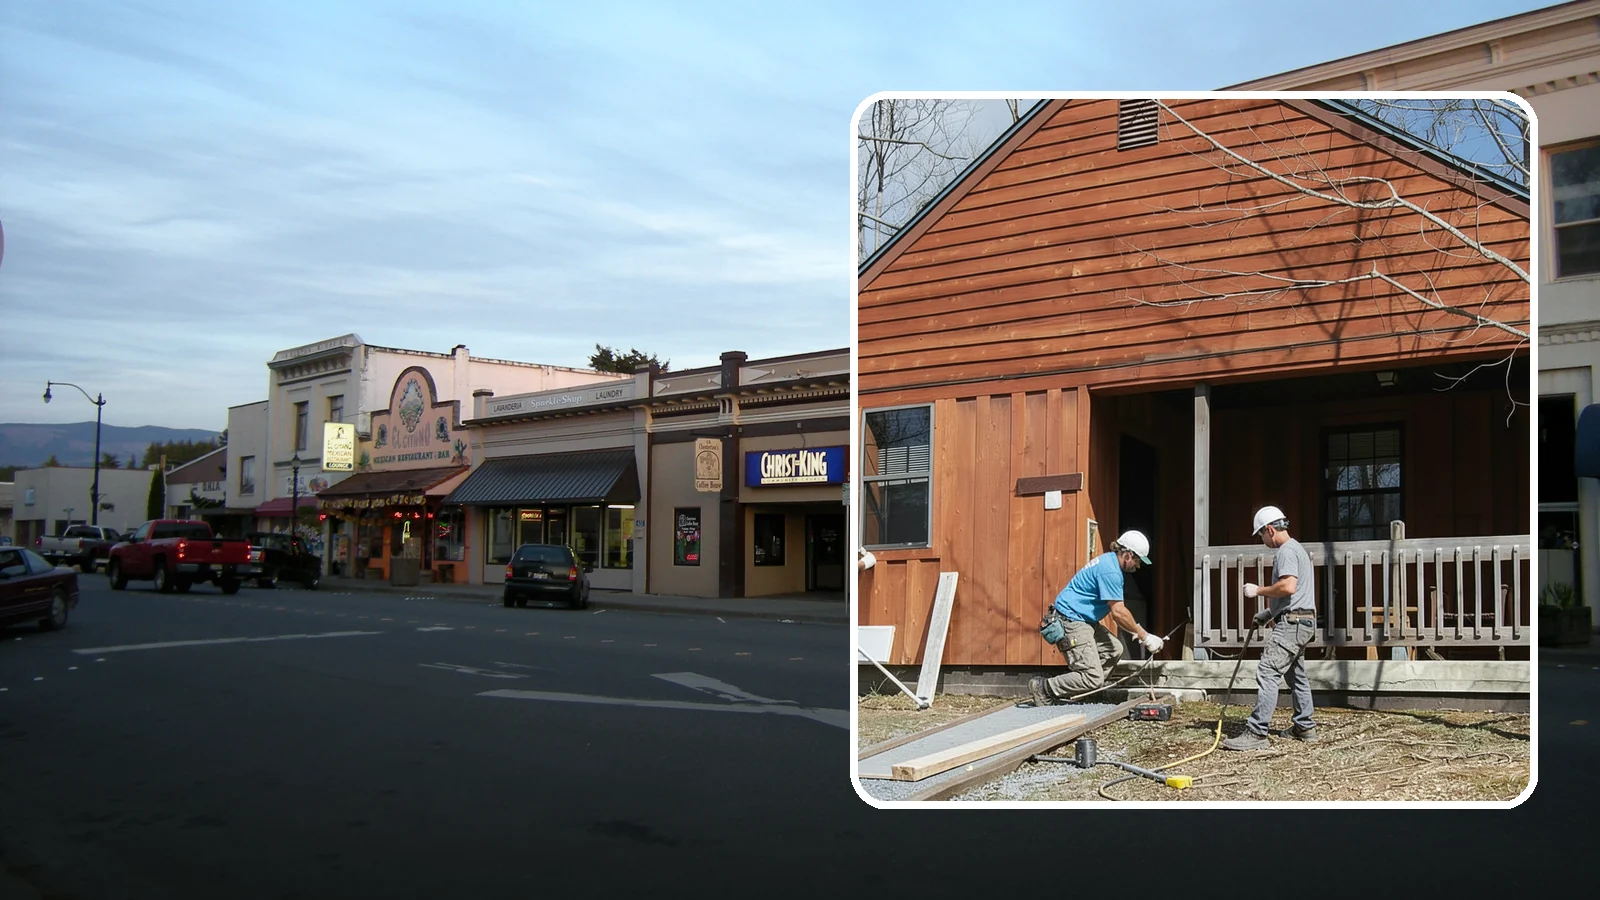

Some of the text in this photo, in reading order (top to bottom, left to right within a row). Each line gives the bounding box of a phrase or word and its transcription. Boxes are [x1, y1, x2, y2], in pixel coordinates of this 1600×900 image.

[561, 394, 583, 405] Shop
[595, 389, 624, 400] LAUNDRY
[373, 450, 450, 464] MEXICAN RESTAURANT BAR
[760, 450, 828, 478] CHRIST KING
[696, 480, 709, 489] Coffee
